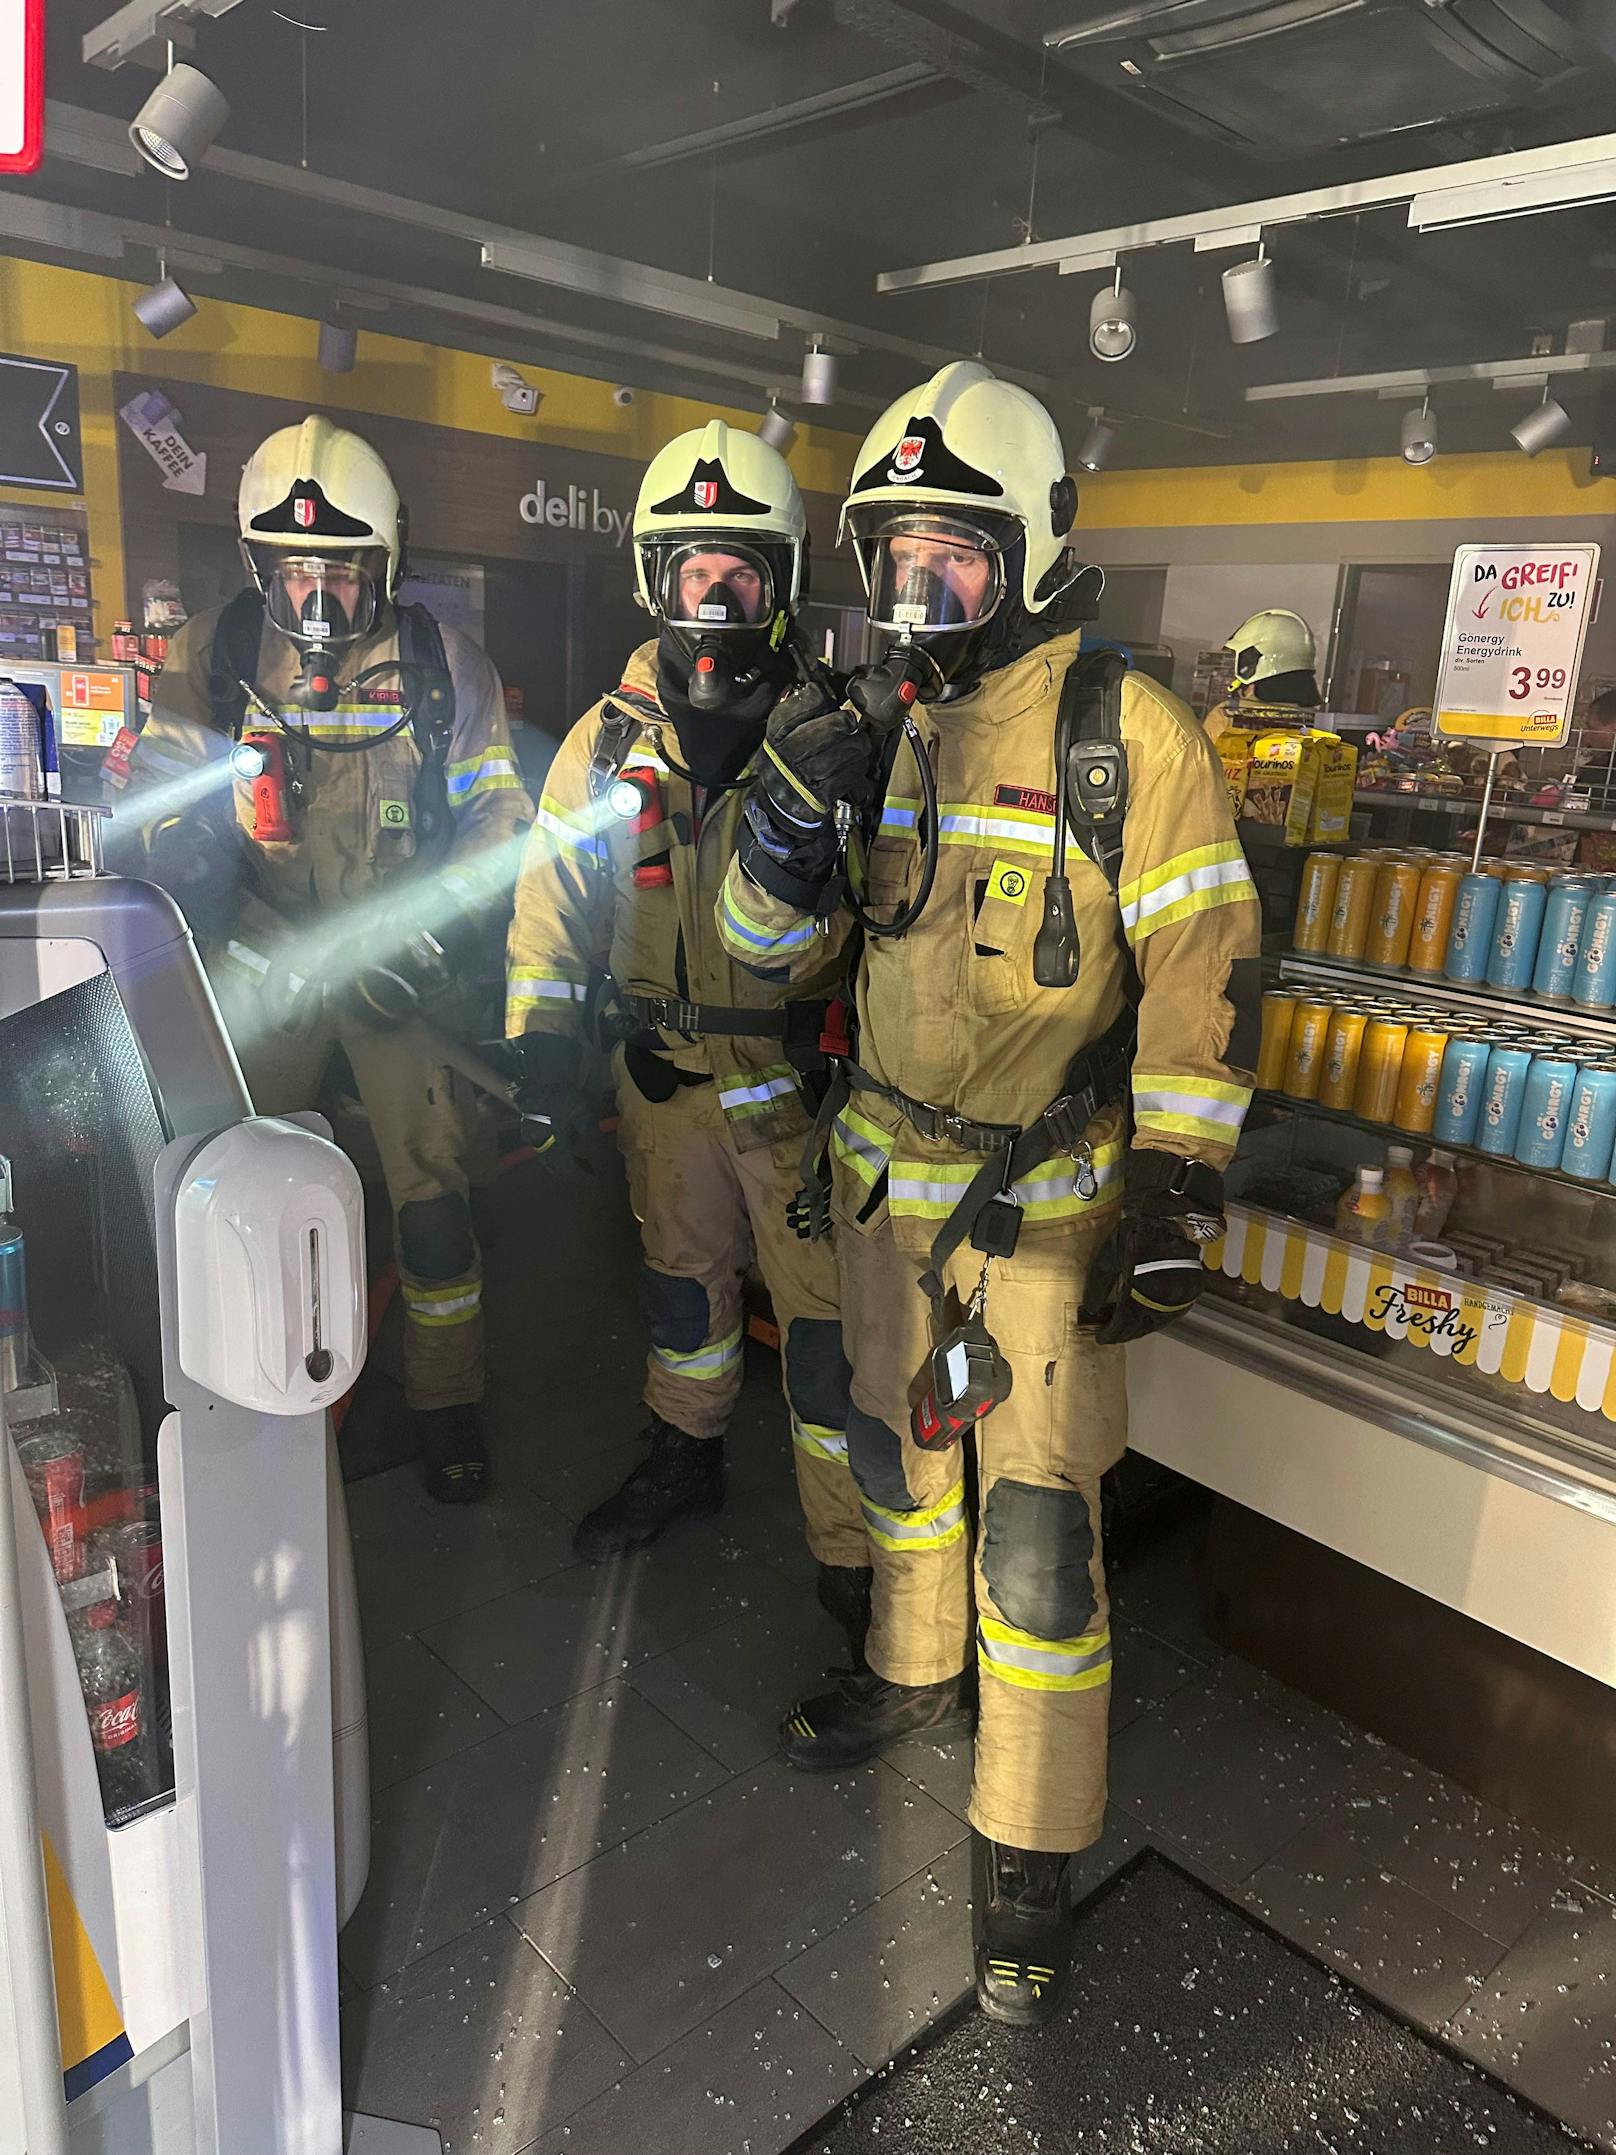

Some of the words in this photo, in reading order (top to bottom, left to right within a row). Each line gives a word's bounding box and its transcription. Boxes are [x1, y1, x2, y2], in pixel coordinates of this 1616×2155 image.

[143, 428, 185, 478] KAFFEE
[164, 435, 194, 470] DEIN
[520, 480, 587, 530] deli
[593, 489, 632, 548] by
[1475, 564, 1498, 582] DA
[1499, 596, 1559, 624] ICH
[1547, 591, 1576, 609] ZU!
[1458, 632, 1505, 646] Gönergy
[1456, 645, 1523, 658] Energydrink
[1520, 724, 1559, 732] Unterwegs
[1534, 715, 1556, 725] BILLA
[1406, 1288, 1450, 1309] BILLA
[1369, 1285, 1478, 1354] Freshy
